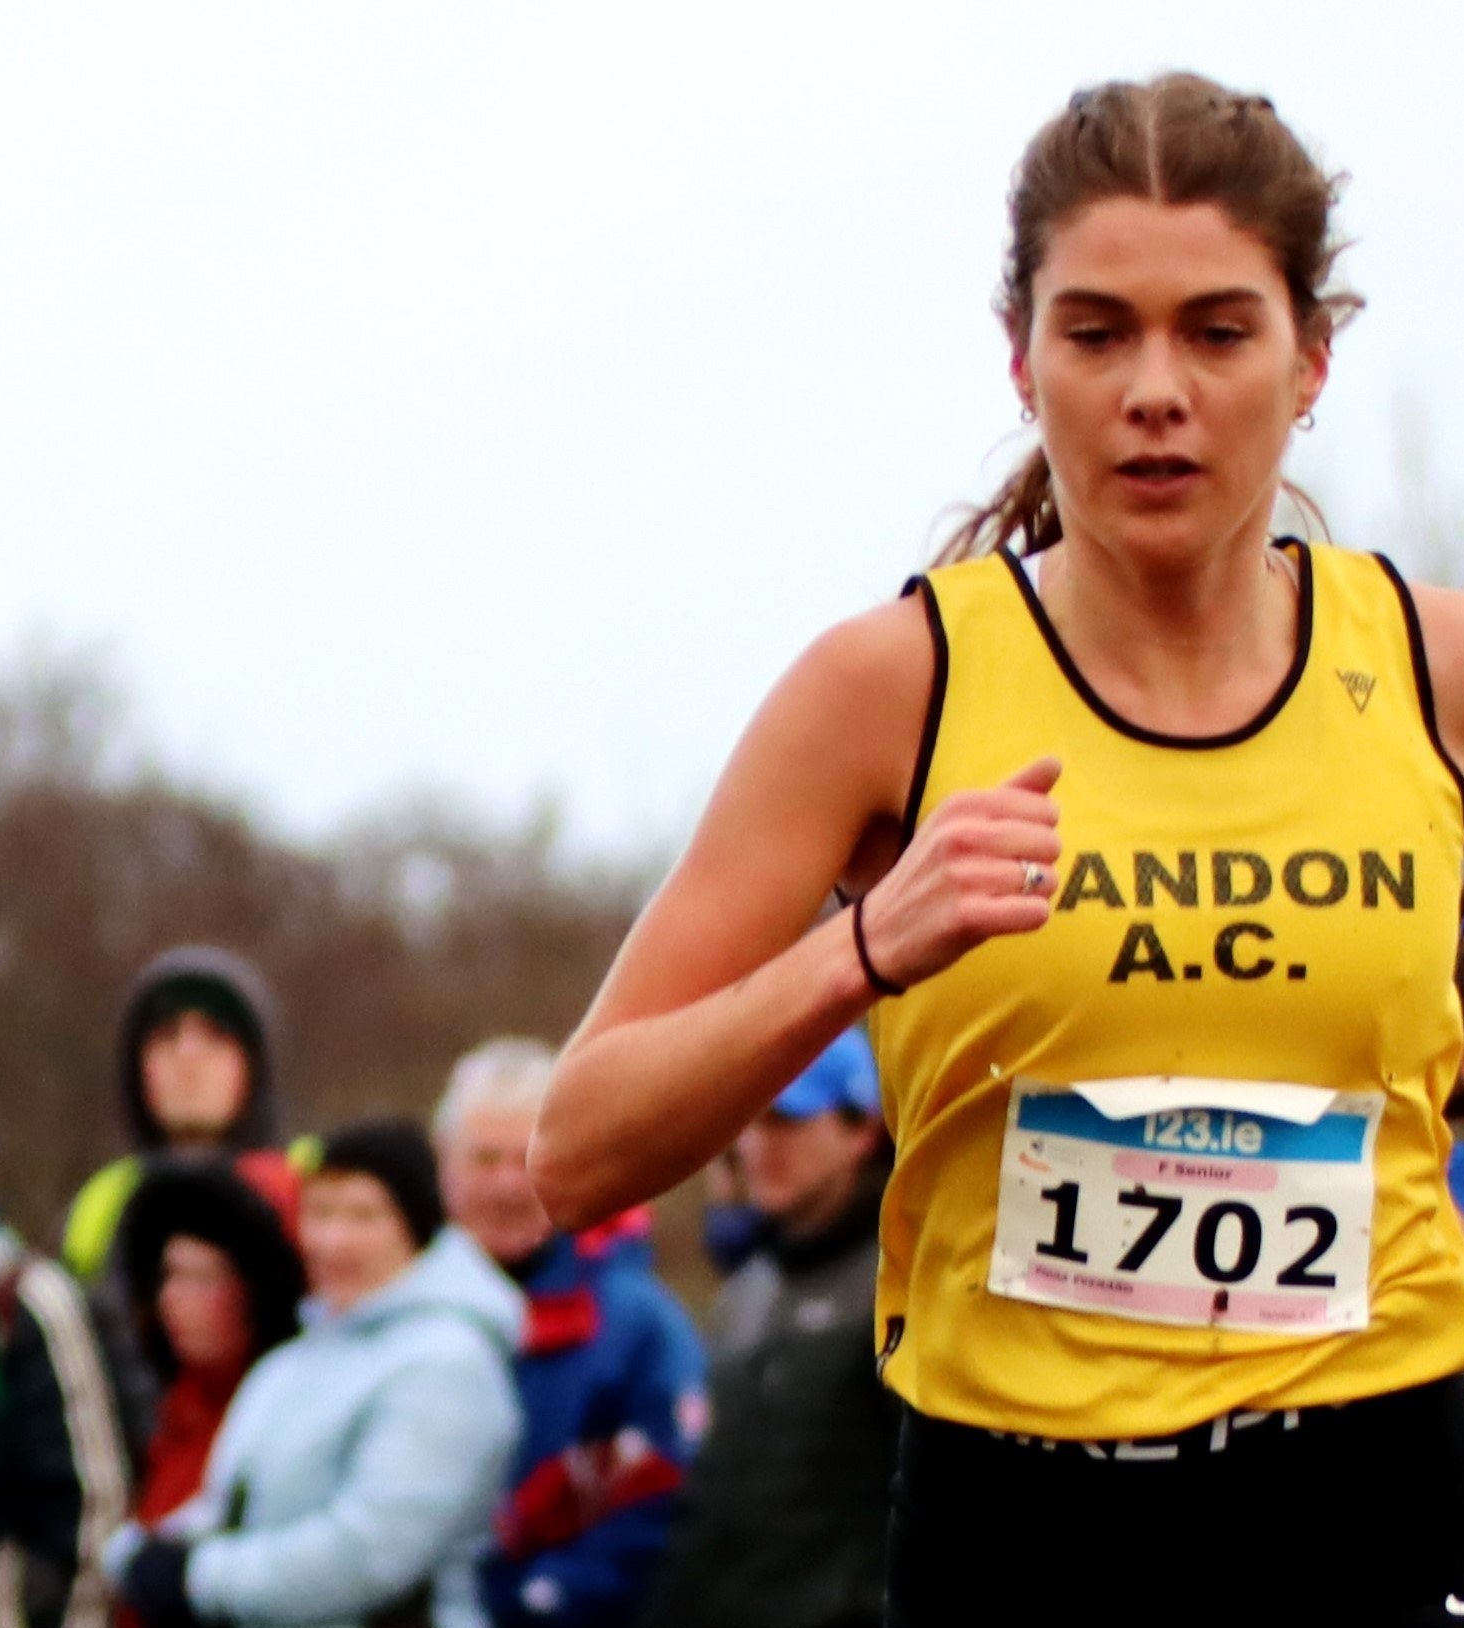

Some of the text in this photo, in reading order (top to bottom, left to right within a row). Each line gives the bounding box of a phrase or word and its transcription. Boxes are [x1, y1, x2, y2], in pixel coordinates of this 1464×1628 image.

[1055, 850, 1415, 911] ANDON
[1107, 922, 1307, 983] A.C.
[1174, 1163, 1233, 1179] Senior
[1035, 1181, 1337, 1289] 1702
